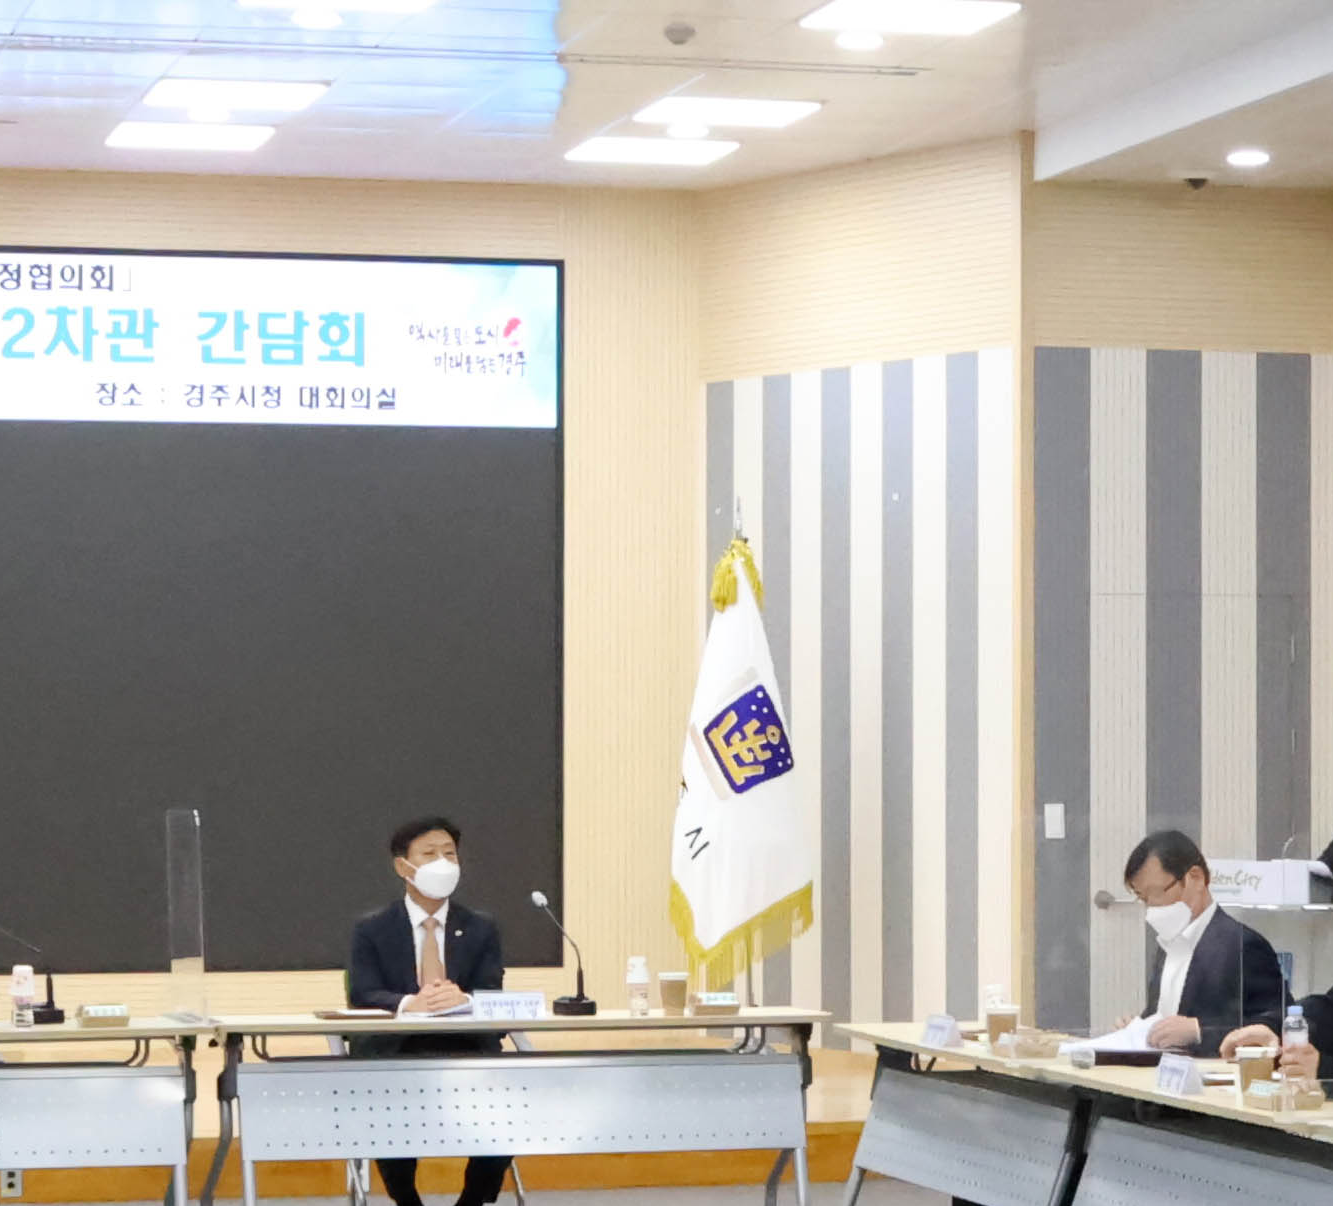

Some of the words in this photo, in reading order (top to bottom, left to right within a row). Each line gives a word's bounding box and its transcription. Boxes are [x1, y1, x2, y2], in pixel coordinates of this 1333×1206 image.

[196, 309, 366, 367] 간담회
[94, 382, 143, 407] 장소
[298, 385, 396, 411] 대회의실
